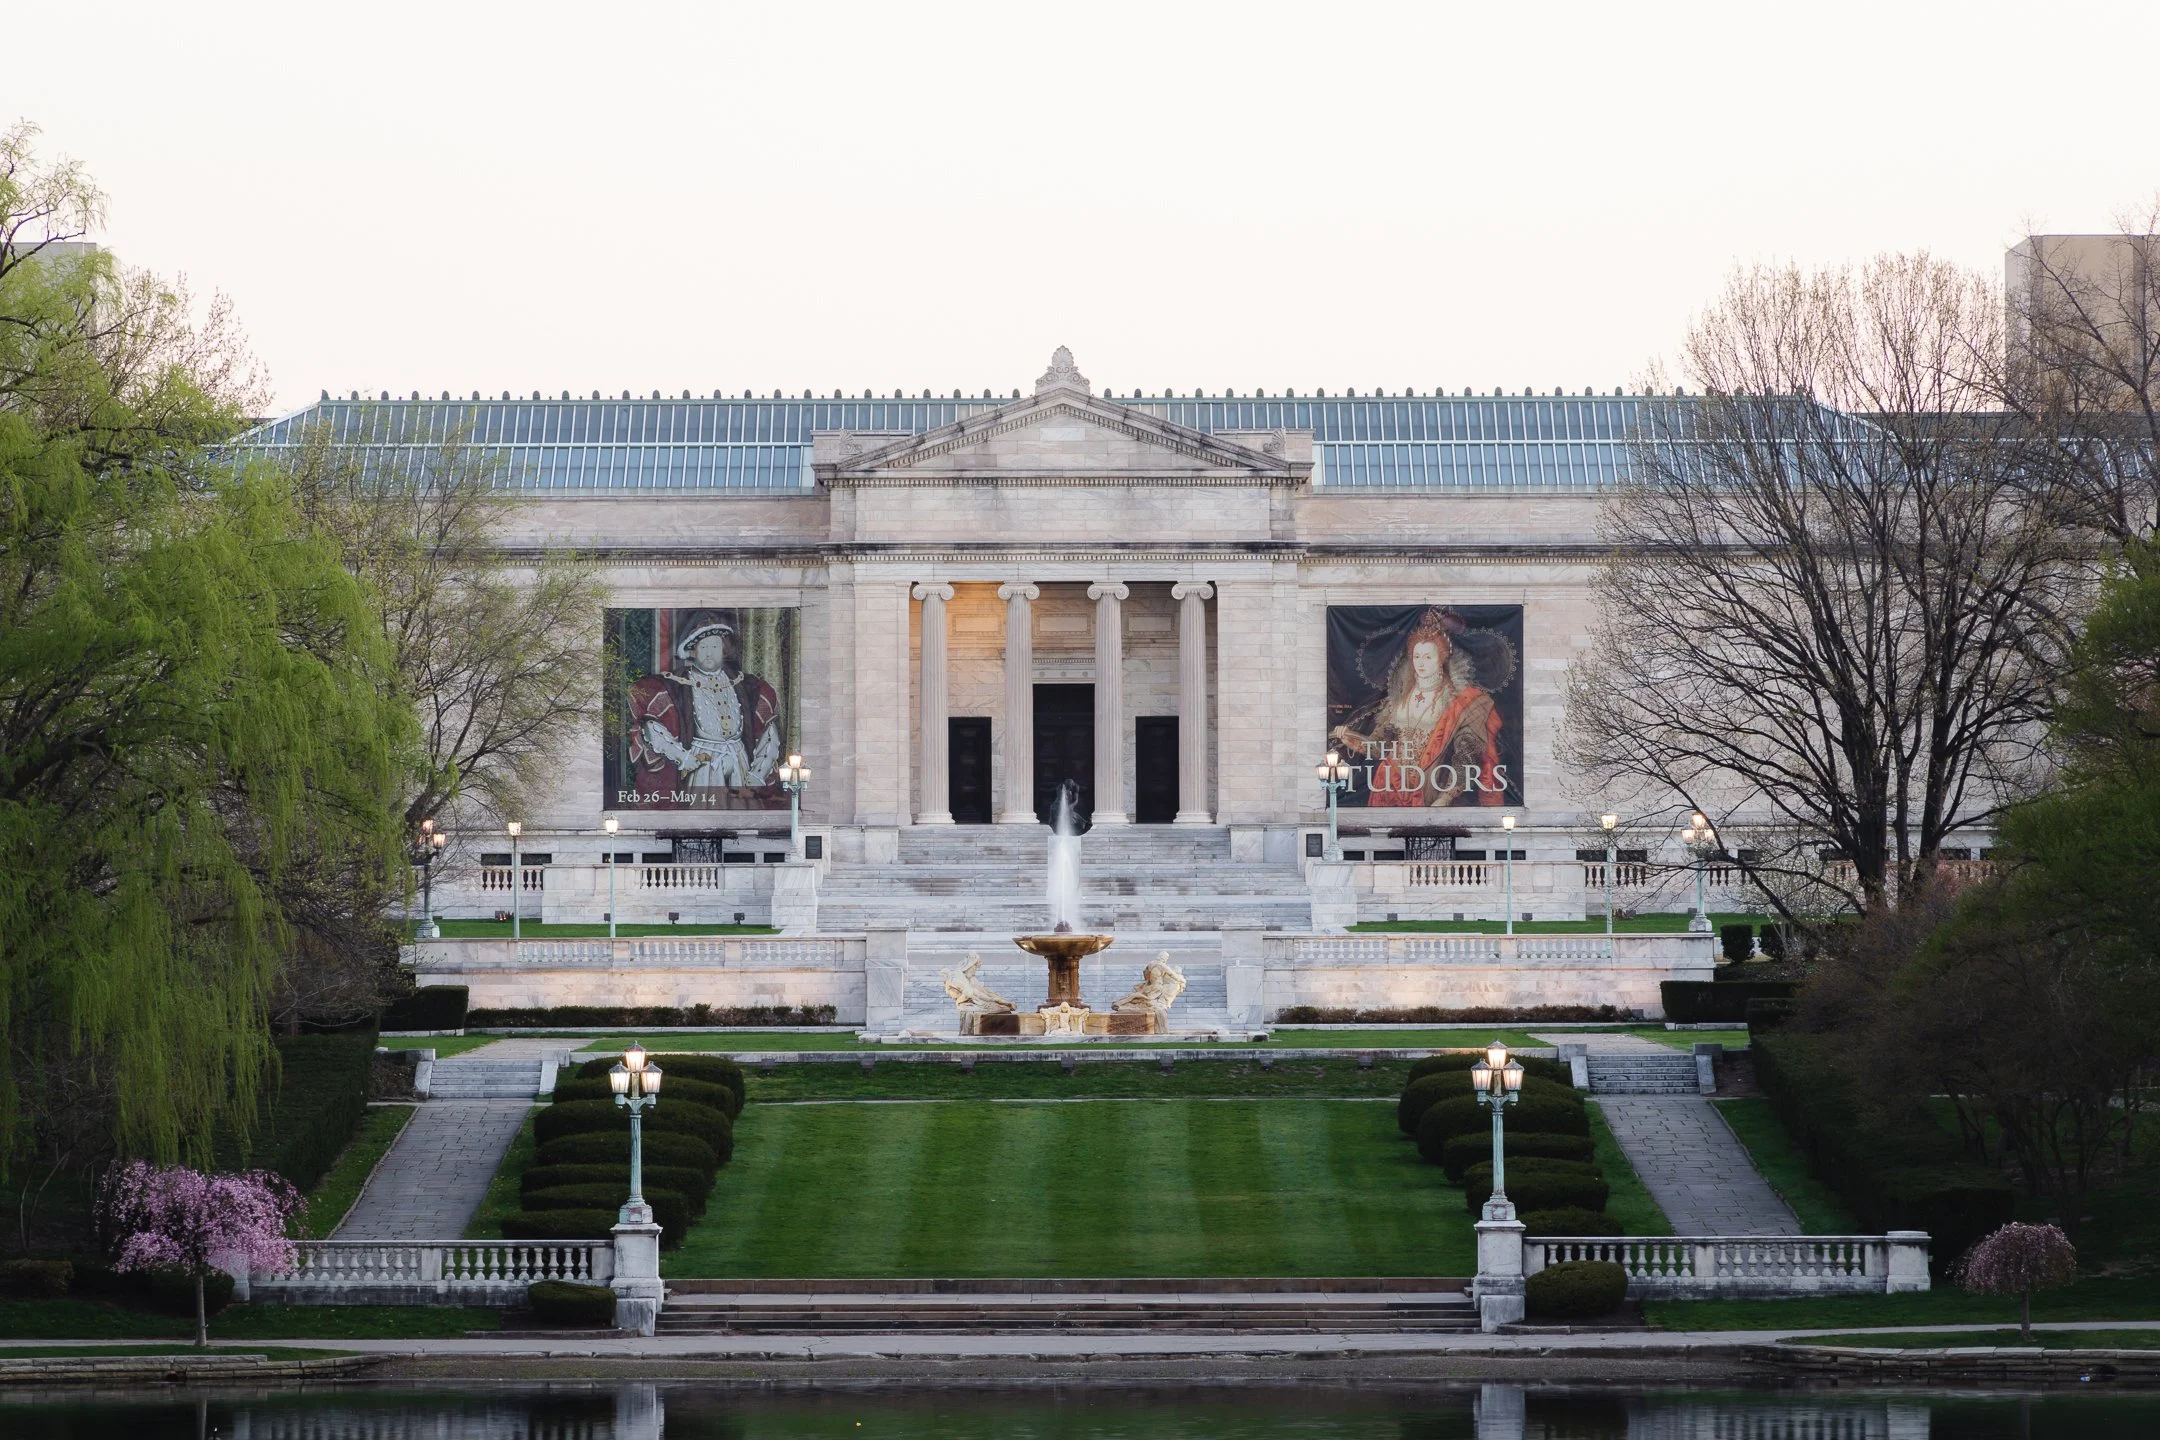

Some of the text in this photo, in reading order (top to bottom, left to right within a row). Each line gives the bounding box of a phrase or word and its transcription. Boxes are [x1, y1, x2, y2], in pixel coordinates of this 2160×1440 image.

[1361, 740, 1415, 761] THE
[1345, 764, 1508, 793] TUDORS
[617, 789, 640, 803] Feb
[701, 793, 717, 806] 14
